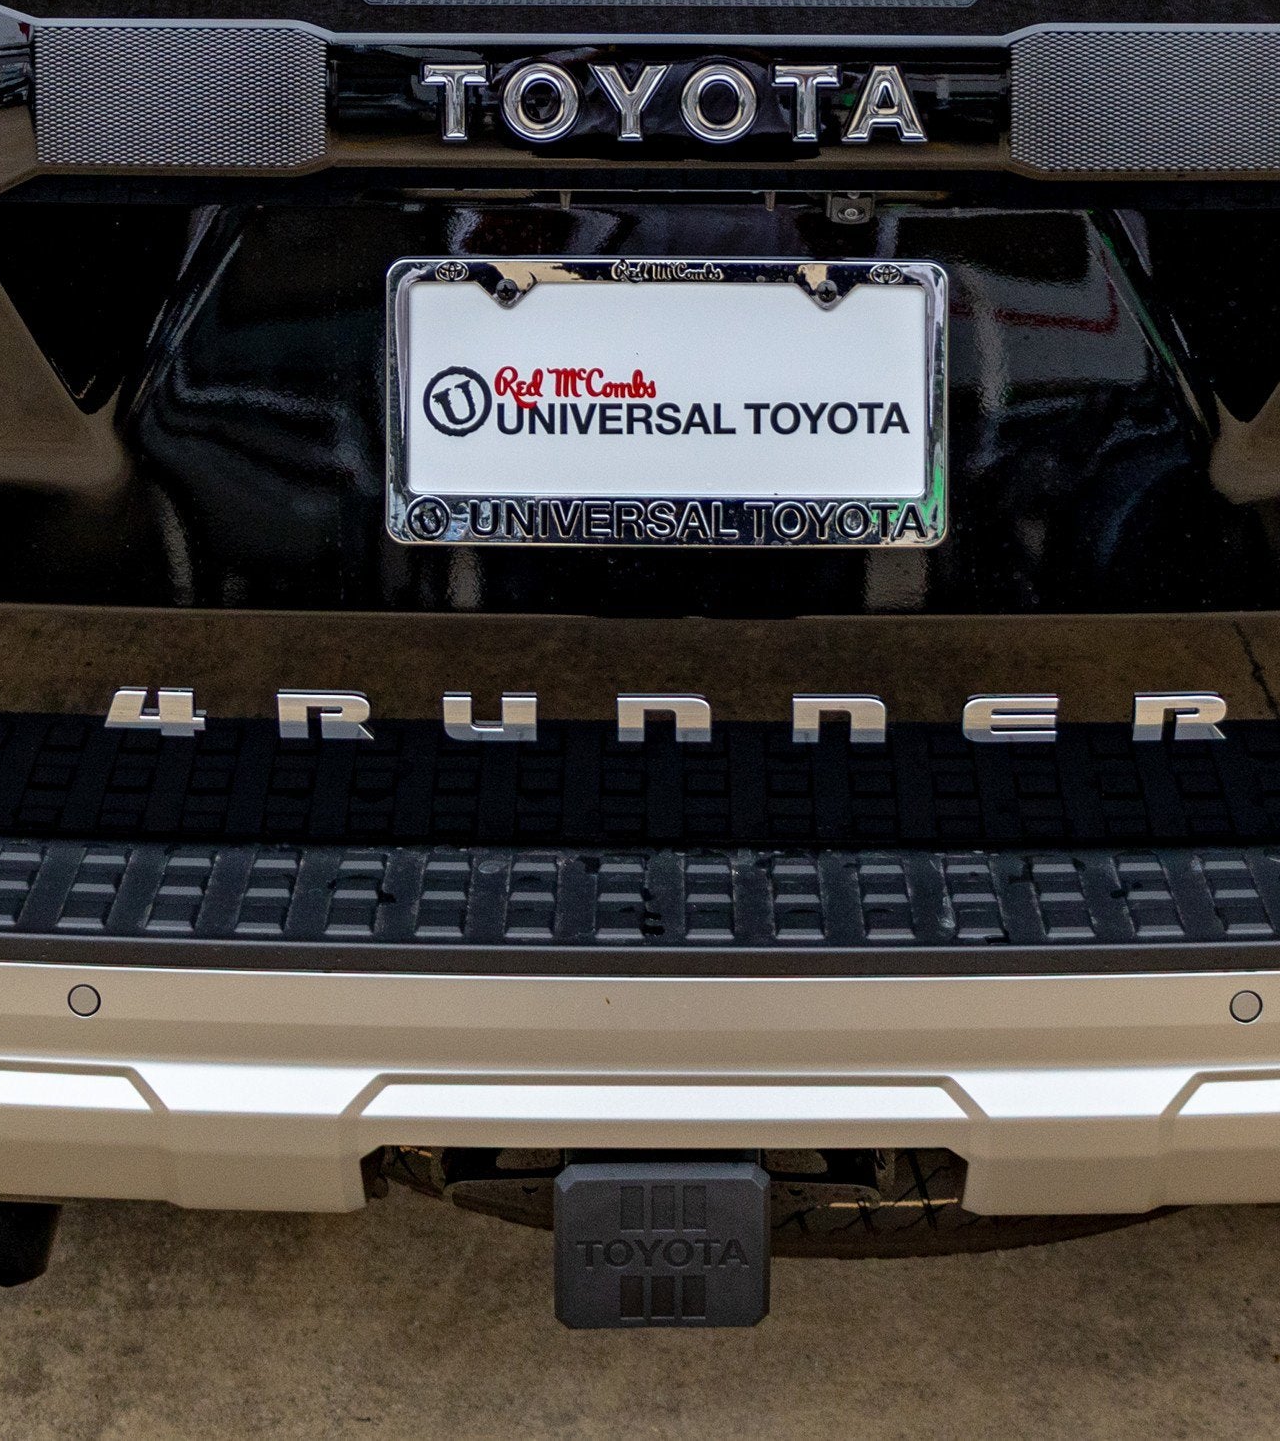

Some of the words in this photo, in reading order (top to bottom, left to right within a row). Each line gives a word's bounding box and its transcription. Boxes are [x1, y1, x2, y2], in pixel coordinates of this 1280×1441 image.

[422, 63, 927, 143] TOYOTA
[611, 259, 647, 282] Red
[494, 366, 543, 408] Red
[547, 367, 656, 398] McCombs
[496, 402, 737, 435] UNIVERSAL
[744, 401, 910, 435] TOYOTA
[468, 499, 739, 539] UNIVERSAL
[743, 501, 928, 539] TOYOTA
[576, 1238, 750, 1270] TOYOTA
